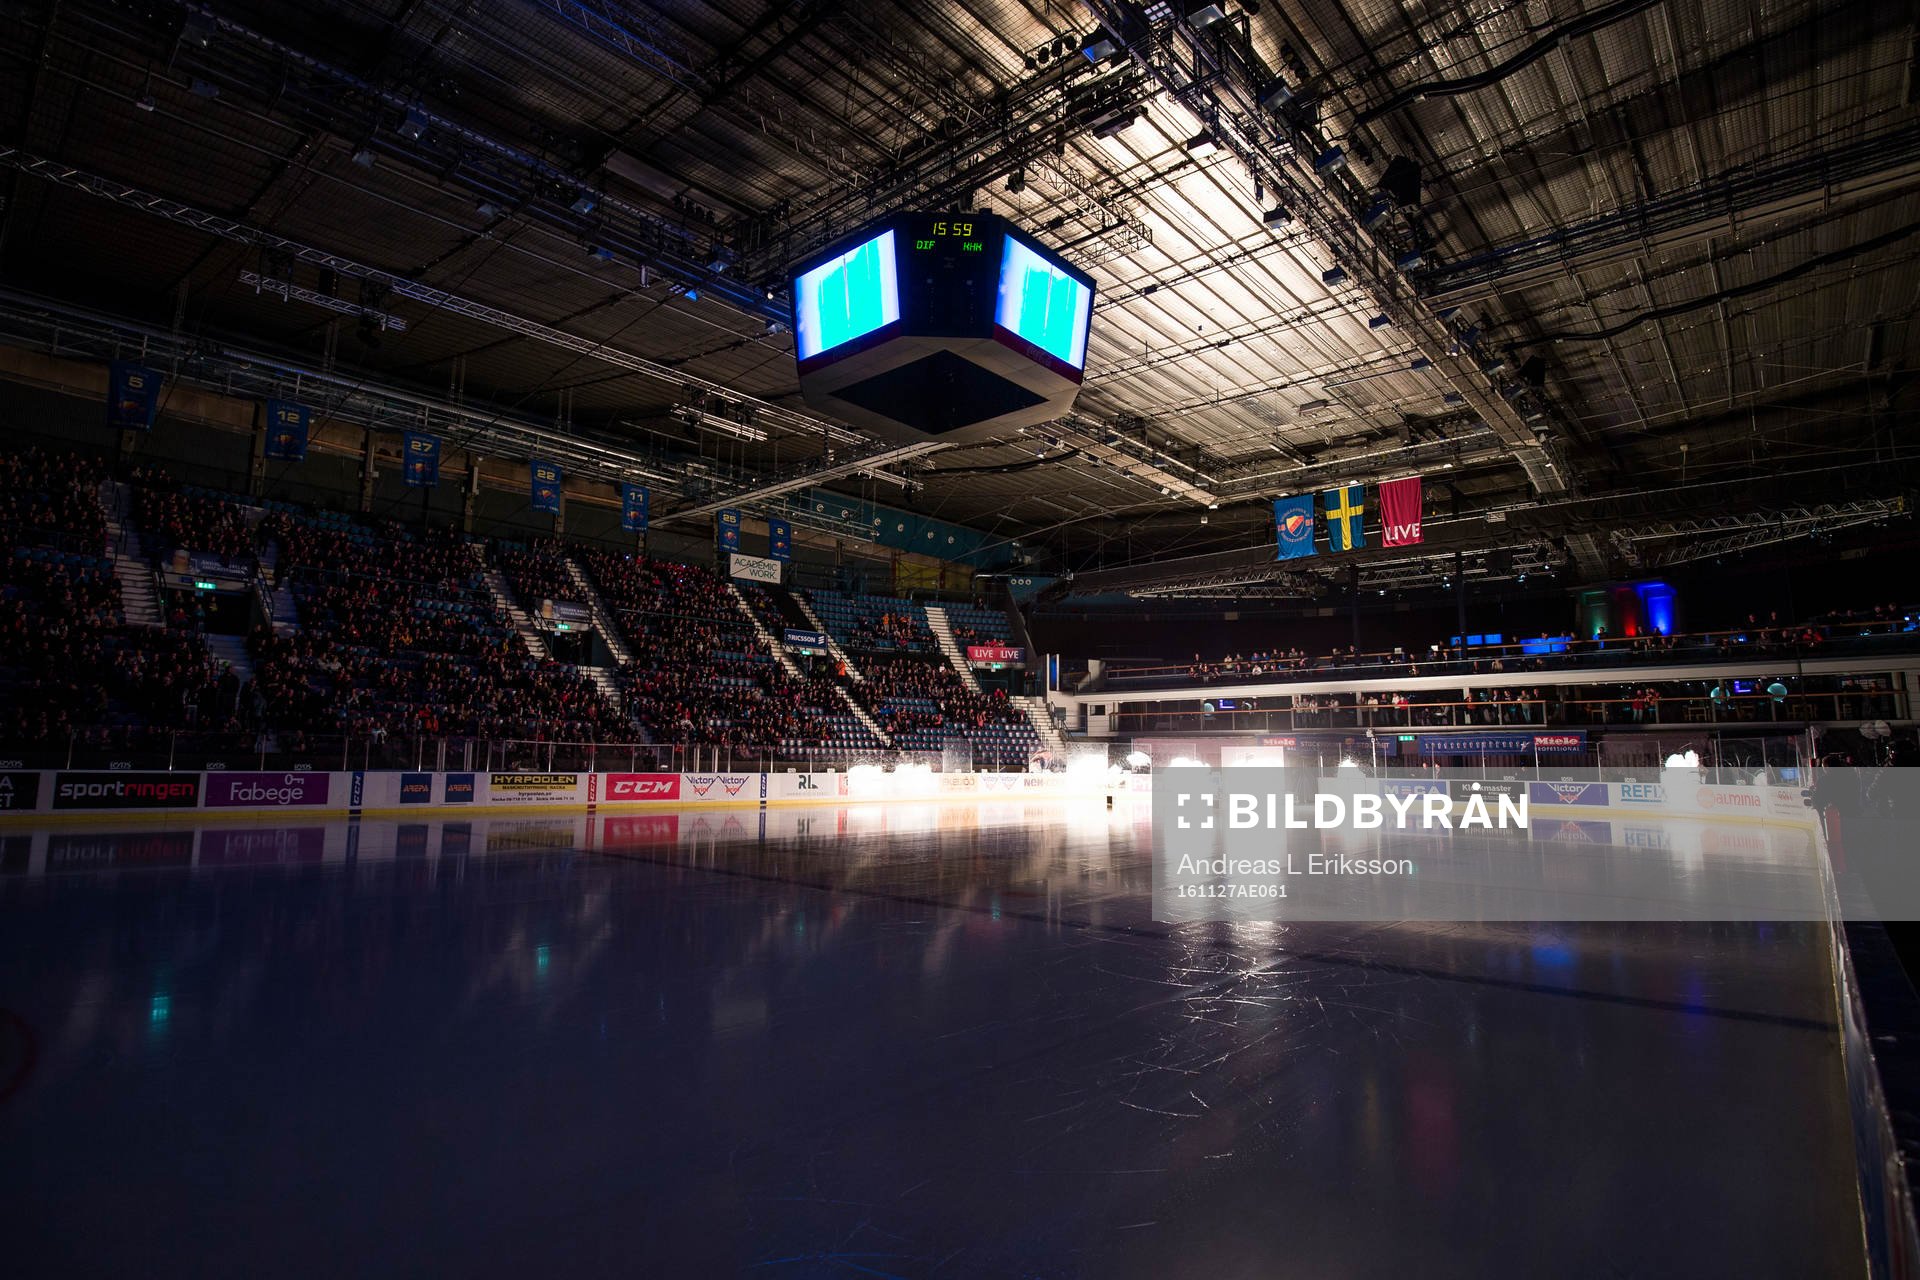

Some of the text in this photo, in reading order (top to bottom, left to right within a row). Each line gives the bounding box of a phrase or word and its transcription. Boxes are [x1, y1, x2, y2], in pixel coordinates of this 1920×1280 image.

[916, 240, 935, 250] DIF
[128, 375, 144, 389] 5
[277, 410, 300, 424] 12
[411, 440, 433, 452] 27
[1385, 523, 1420, 541] LIVE
[734, 558, 777, 571] ACADEMIC
[974, 649, 1019, 659] LIVE LIVE
[1535, 737, 1579, 745] Miele
[494, 775, 576, 784] HYRPOOLEN
[60, 780, 195, 800] sportringen
[230, 782, 304, 804] Fabege
[613, 781, 674, 794] CCM
[1384, 784, 1440, 795] MECA
[1462, 783, 1511, 792] Klkmaster
